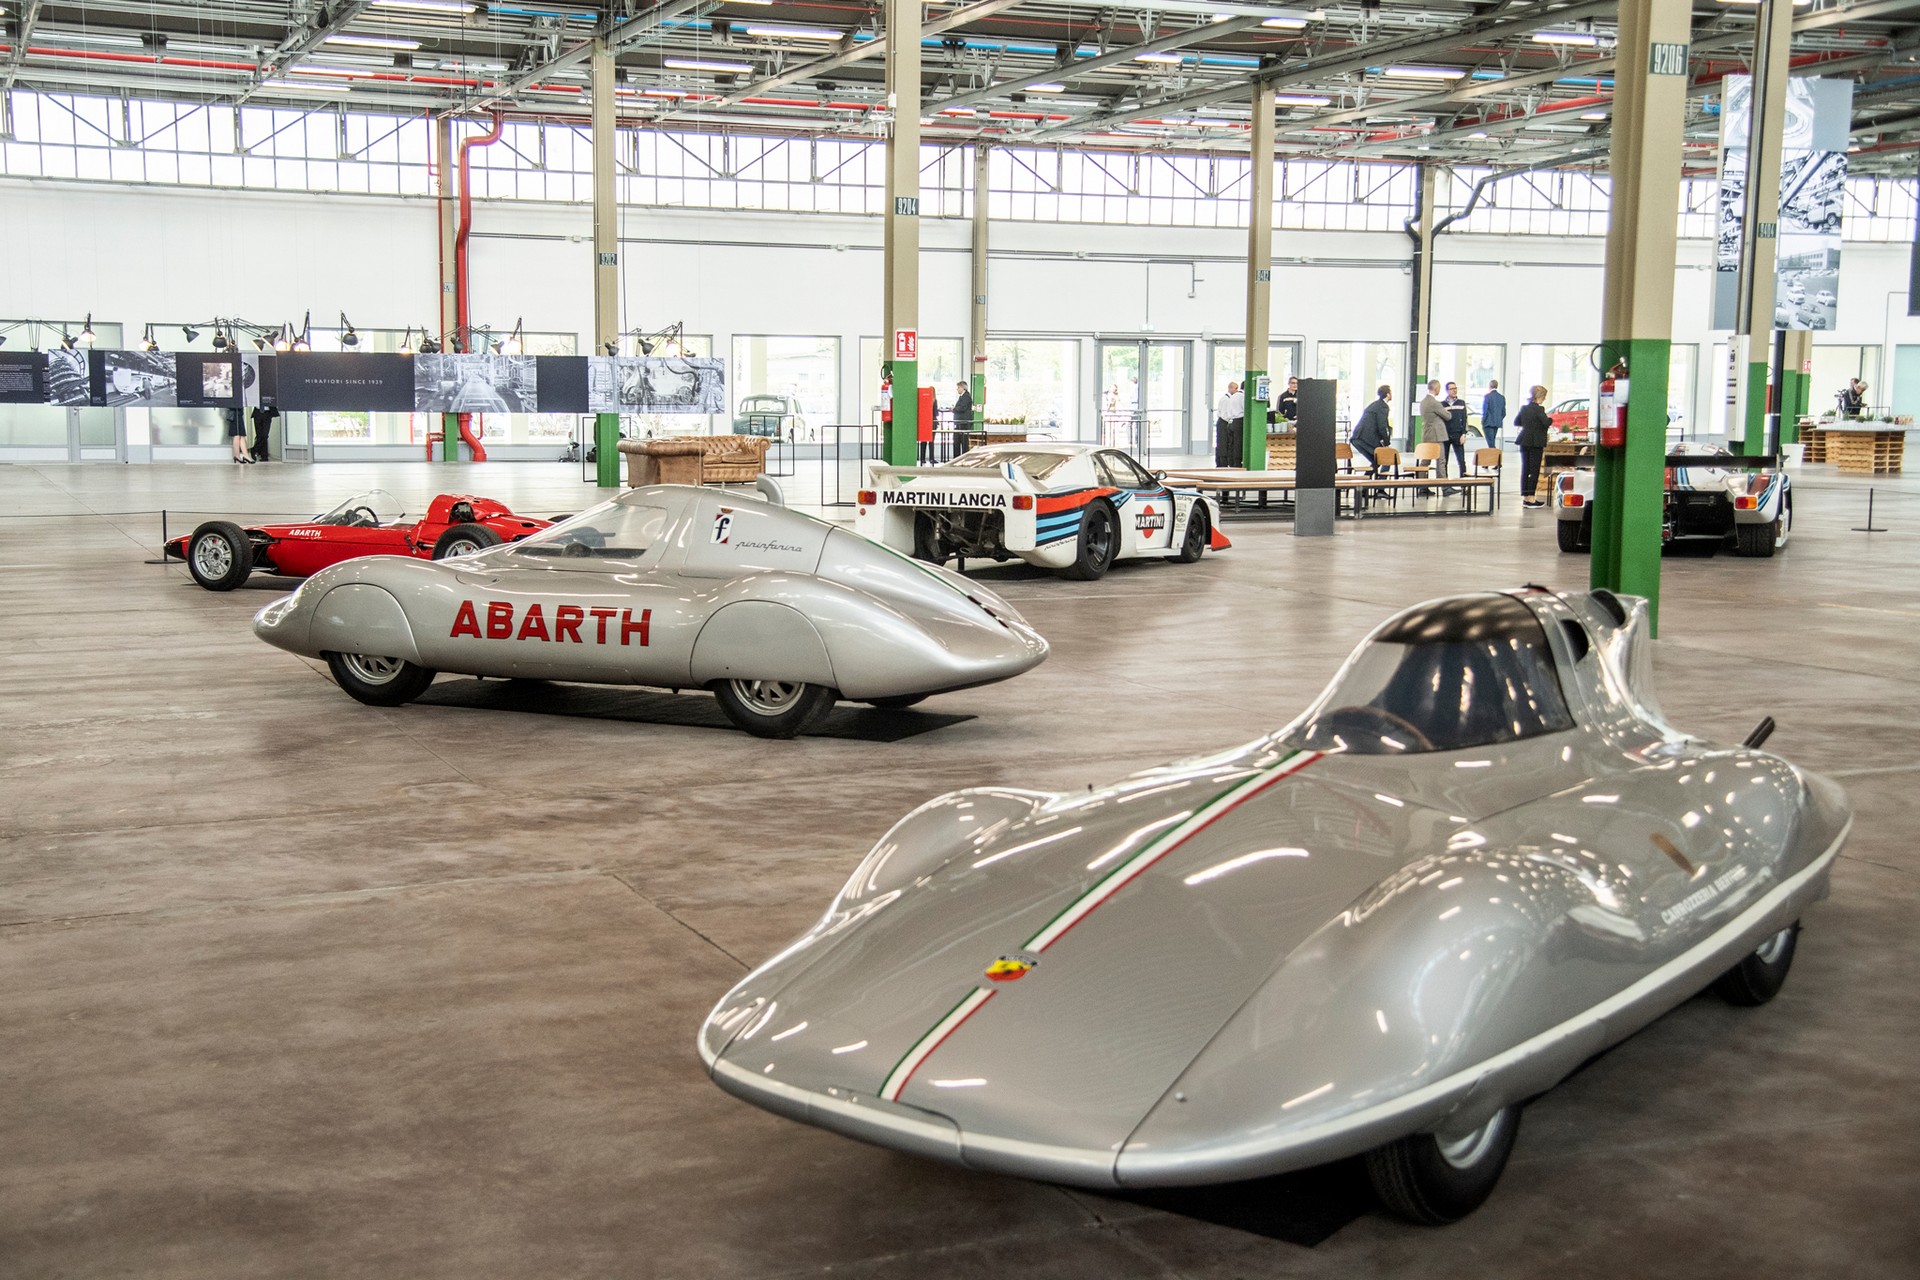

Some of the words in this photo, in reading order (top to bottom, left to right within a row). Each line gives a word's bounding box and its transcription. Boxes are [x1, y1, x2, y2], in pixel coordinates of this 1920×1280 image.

[1654, 44, 1683, 74] 9206
[898, 197, 916, 215] 9204
[883, 491, 945, 505] MARTINI
[949, 493, 1006, 507] LANCIA
[1135, 514, 1164, 529] MARTINI
[289, 529, 322, 537] ABARTH
[735, 540, 802, 552] pininfarina
[450, 600, 652, 647] ABARTH
[1661, 884, 1719, 925] CARROZZERIA
